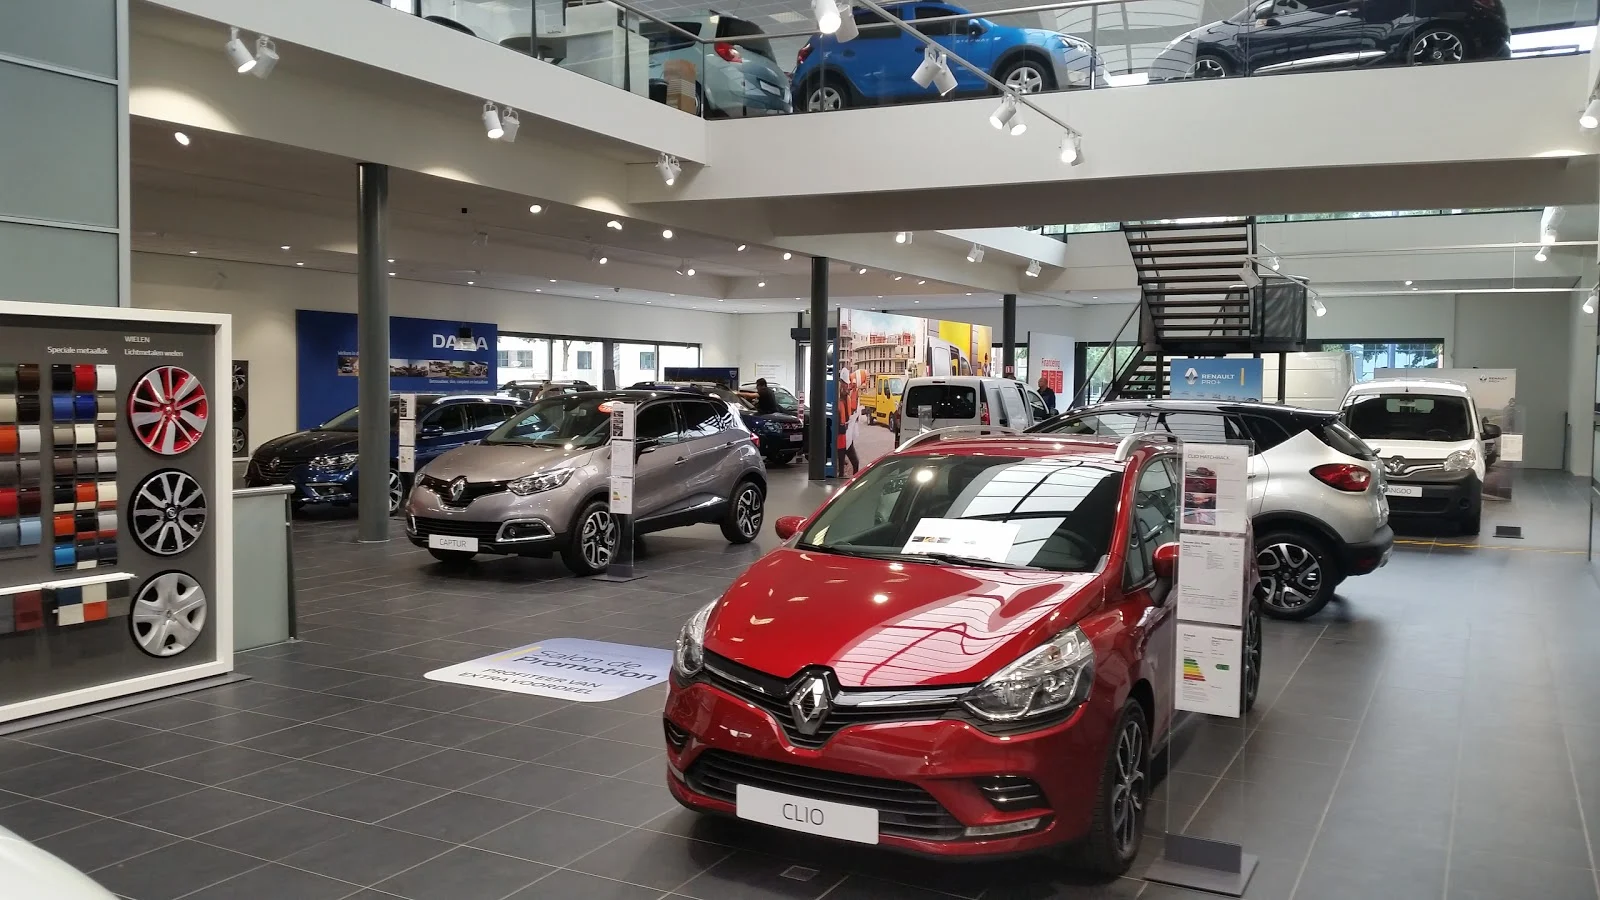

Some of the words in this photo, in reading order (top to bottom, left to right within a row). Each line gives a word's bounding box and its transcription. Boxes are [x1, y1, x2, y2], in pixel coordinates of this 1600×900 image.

[123, 335, 151, 343] WIELEN
[432, 333, 489, 351] DAA
[47, 346, 76, 354] Speciale
[124, 348, 164, 357] Lichtmetalen
[439, 538, 467, 548] CAPTUR
[533, 650, 604, 664] Salon
[607, 661, 642, 669] de
[458, 672, 509, 682] EXTRA
[511, 680, 593, 695] VOORDEEL
[482, 668, 568, 683] PROFITEER
[569, 680, 604, 688] VAN
[782, 803, 825, 826] CLIO
